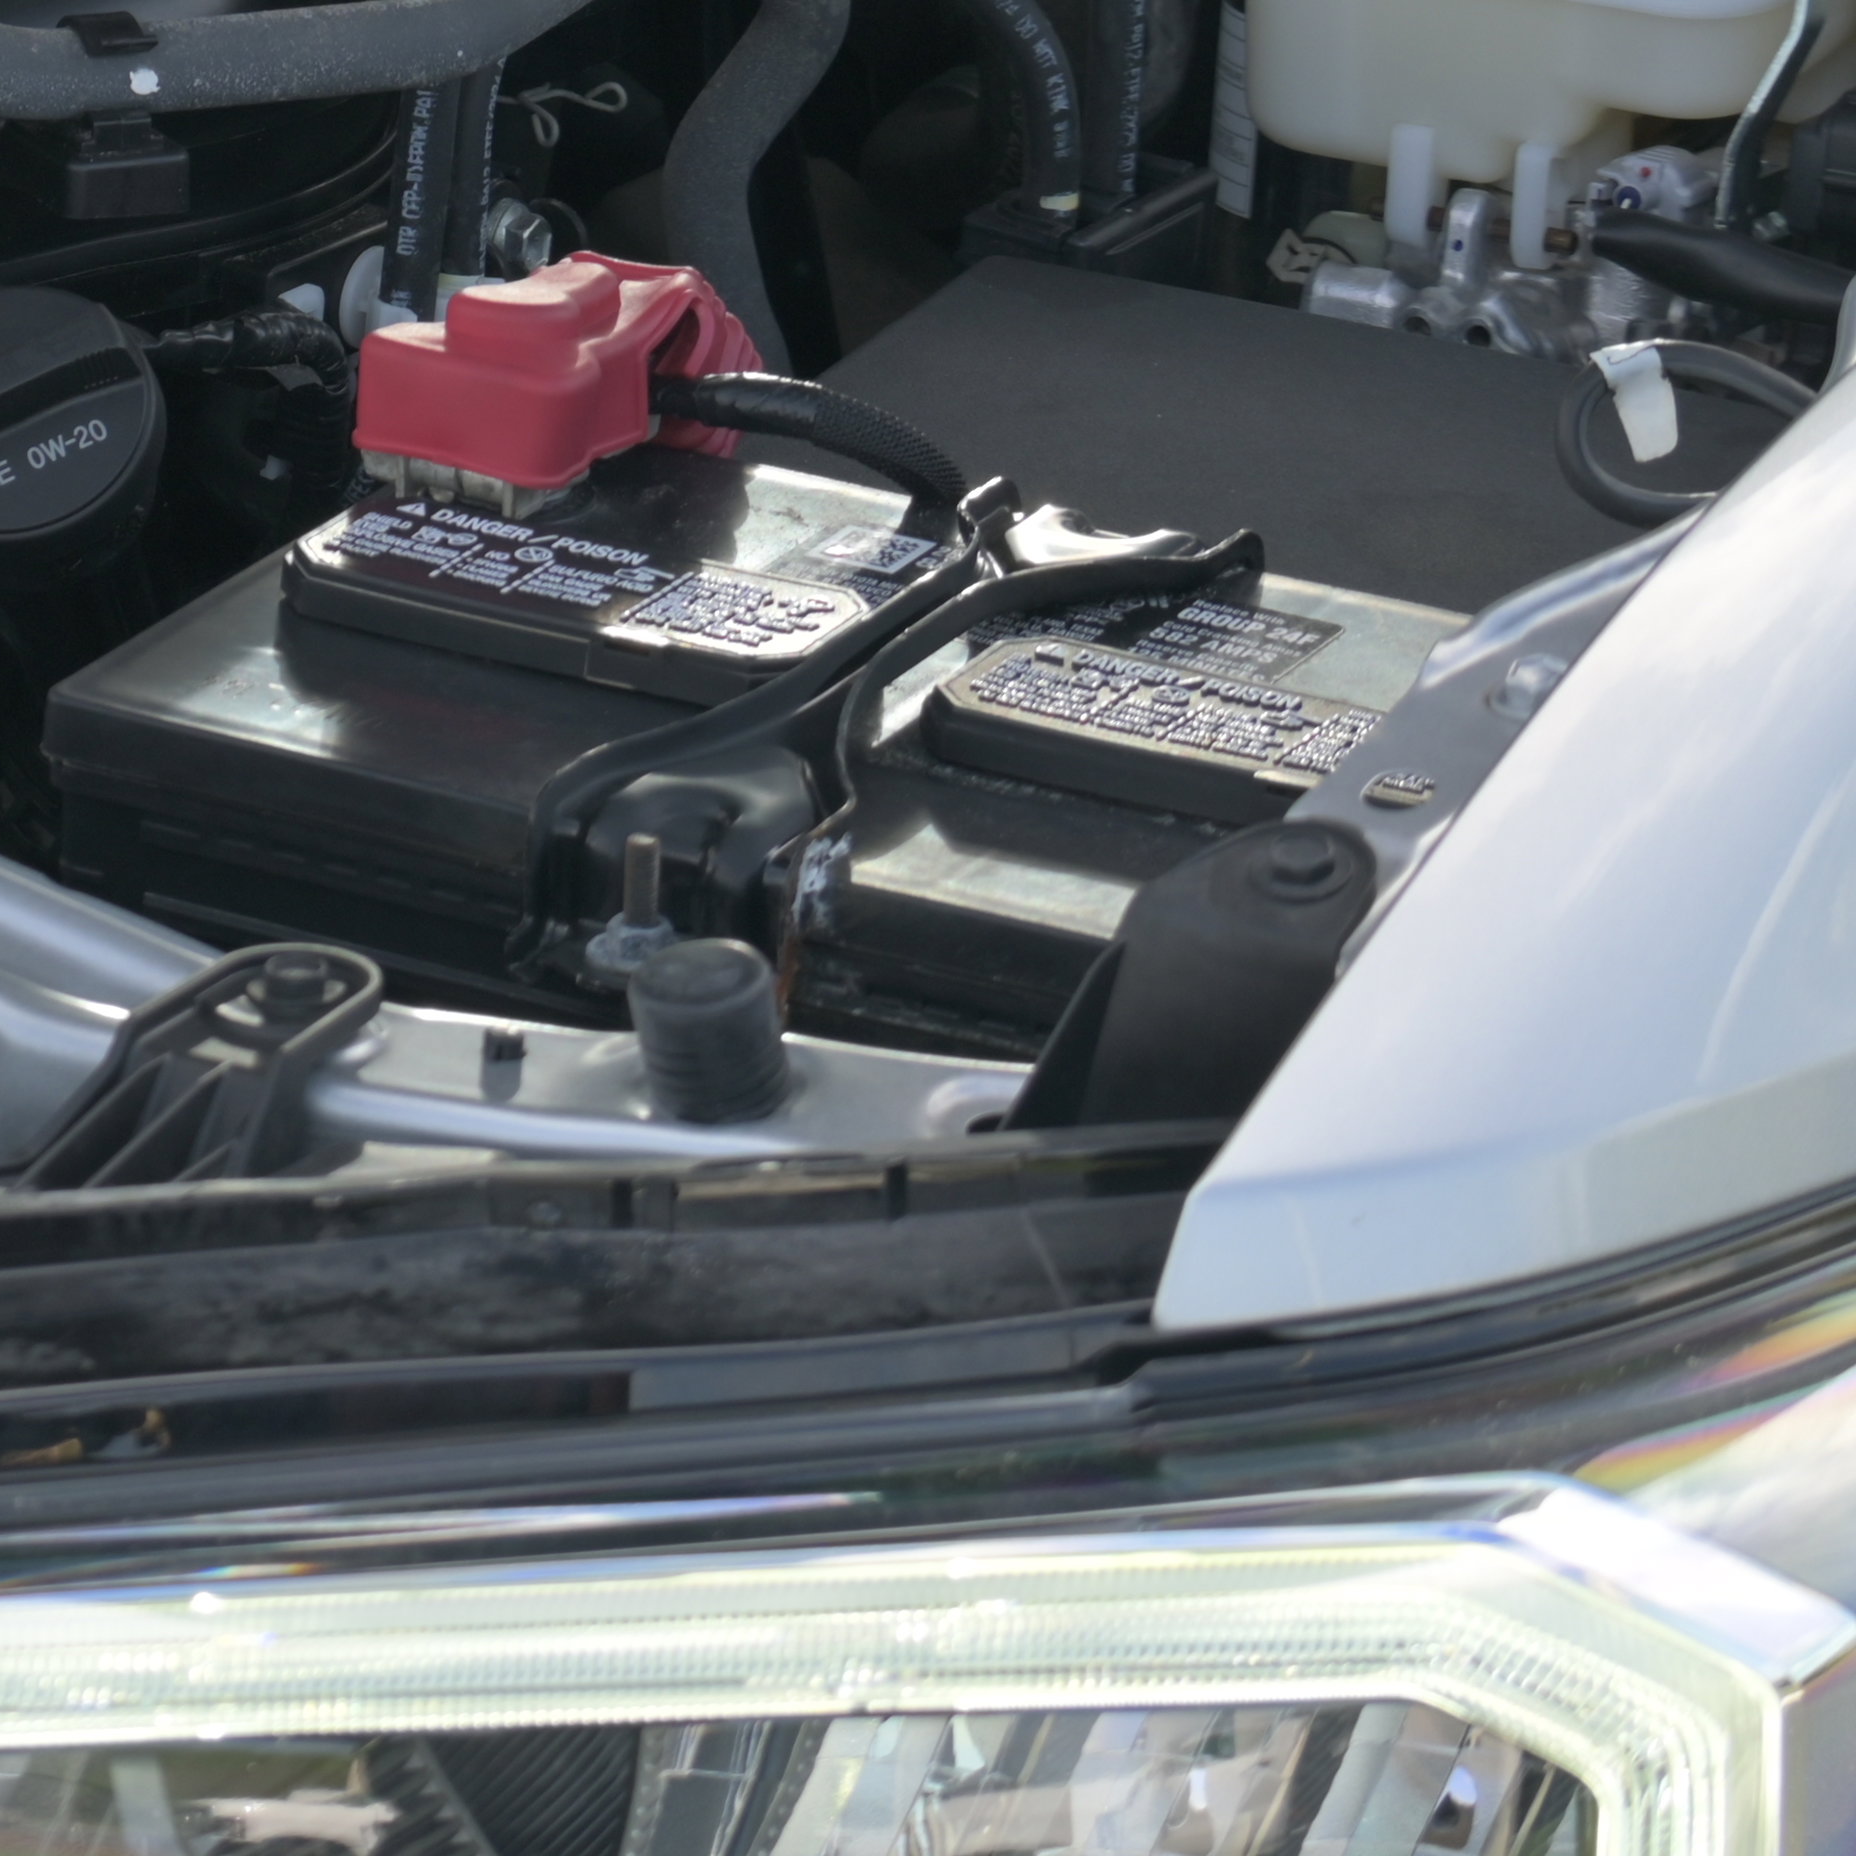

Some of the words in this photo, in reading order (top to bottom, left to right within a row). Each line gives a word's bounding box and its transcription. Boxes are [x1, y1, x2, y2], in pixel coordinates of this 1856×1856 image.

[26, 418, 108, 471] 0W-20
[362, 511, 413, 529] SHIELD
[484, 549, 511, 561] NO
[1176, 606, 1266, 634] GROUP
[1265, 626, 1321, 645] 24F
[1192, 598, 1249, 617] Replace
[1251, 611, 1286, 626] With
[1136, 639, 1194, 657] Reserve
[1195, 652, 1259, 673] Capacity
[1148, 626, 1199, 644] 582
[1199, 639, 1278, 664] AMPS
[1162, 620, 1196, 634] Cold
[1195, 627, 1259, 649] Cranking
[1259, 642, 1304, 658] Amps
